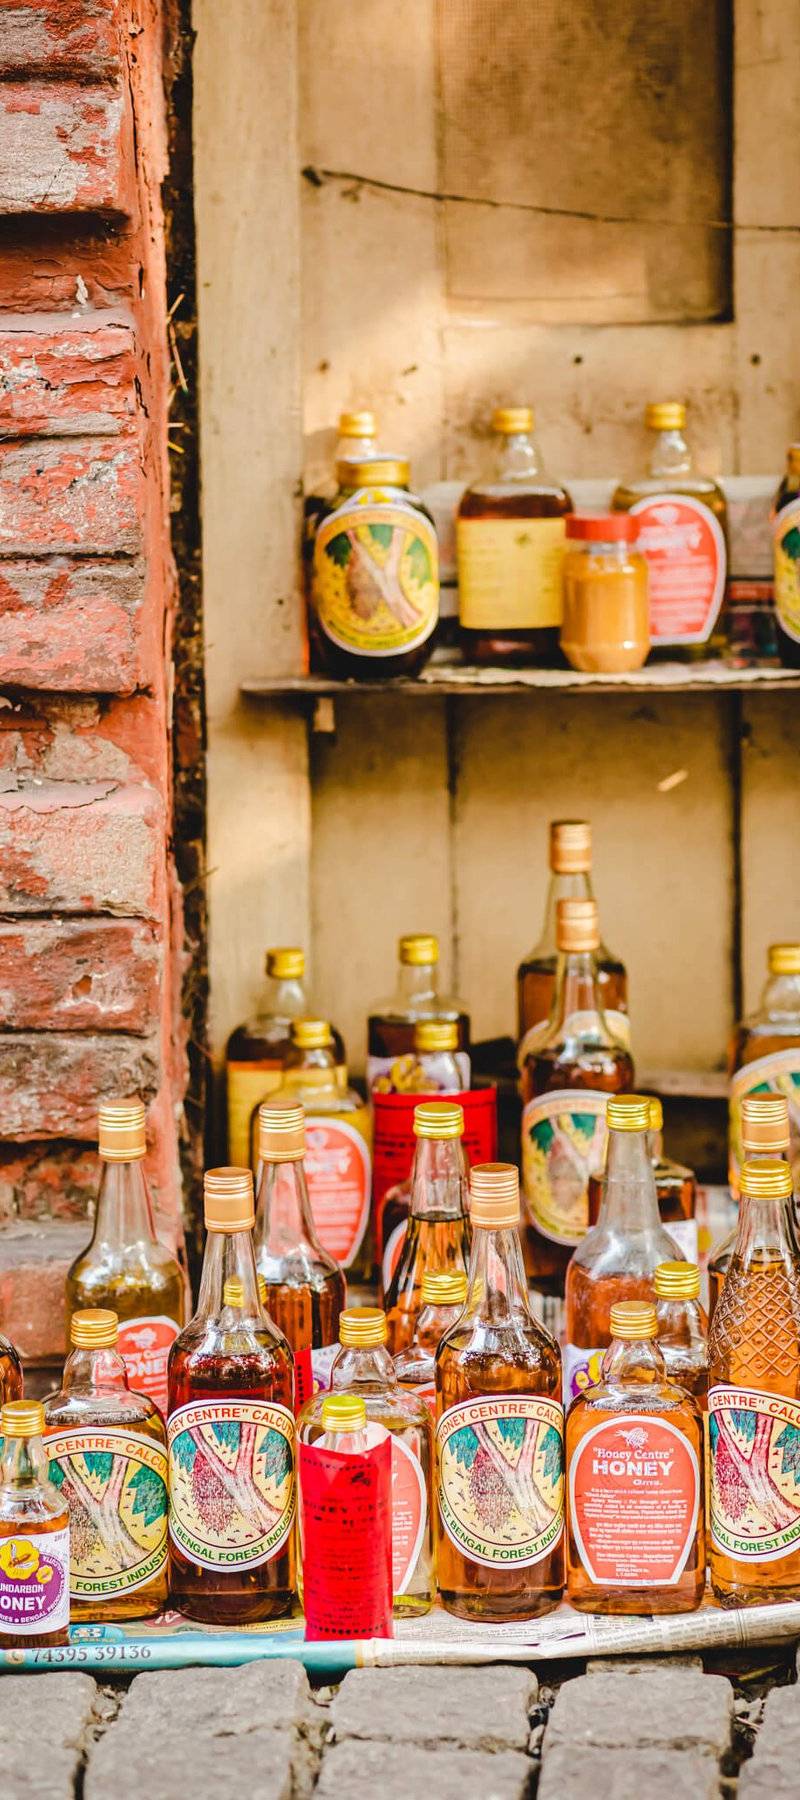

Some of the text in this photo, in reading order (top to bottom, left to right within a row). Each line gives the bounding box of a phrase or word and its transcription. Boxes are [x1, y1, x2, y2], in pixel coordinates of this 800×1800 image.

[186, 1407, 249, 1425] CENTRE"
[469, 1403, 534, 1420] CENTRE"
[55, 1438, 123, 1454] CENTRE"
[592, 1460, 673, 1477] HONEY
[175, 1526, 215, 1560] BENGAL
[218, 1543, 265, 1562] FOREST
[450, 1520, 489, 1556] BENGAL
[492, 1543, 540, 1560] FOREST
[733, 1538, 779, 1552] FOREST
[75, 1577, 125, 1592] FOREST
[31, 1645, 151, 1663] 74395 39136
